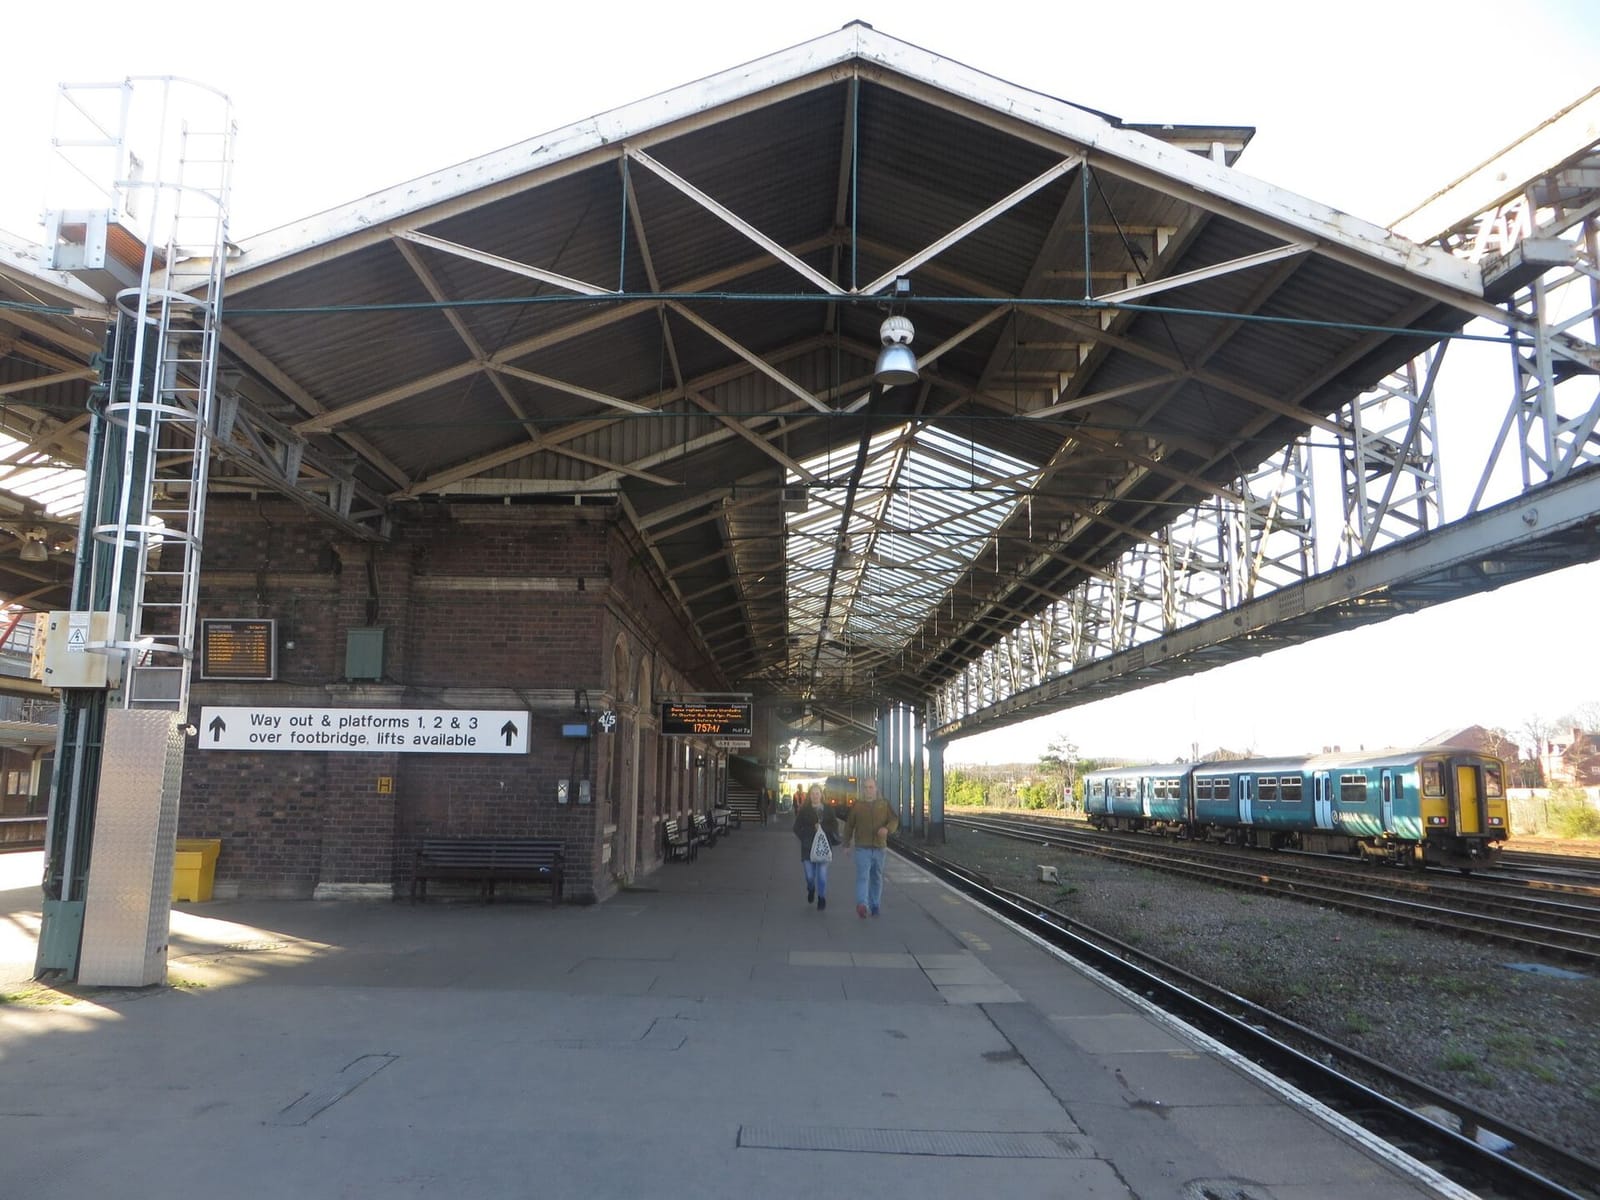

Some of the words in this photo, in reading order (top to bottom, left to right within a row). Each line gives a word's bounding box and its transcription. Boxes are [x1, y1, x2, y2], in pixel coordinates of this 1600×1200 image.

[250, 713, 281, 728] Way
[289, 714, 313, 727] out
[321, 714, 331, 727] &
[339, 715, 410, 729] platforms
[433, 716, 443, 729] 2
[450, 717, 461, 729] &
[468, 717, 478, 730] 3
[249, 732, 282, 743] over
[377, 732, 405, 745] lifts
[413, 733, 477, 746] available
[379, 778, 392, 793] H
